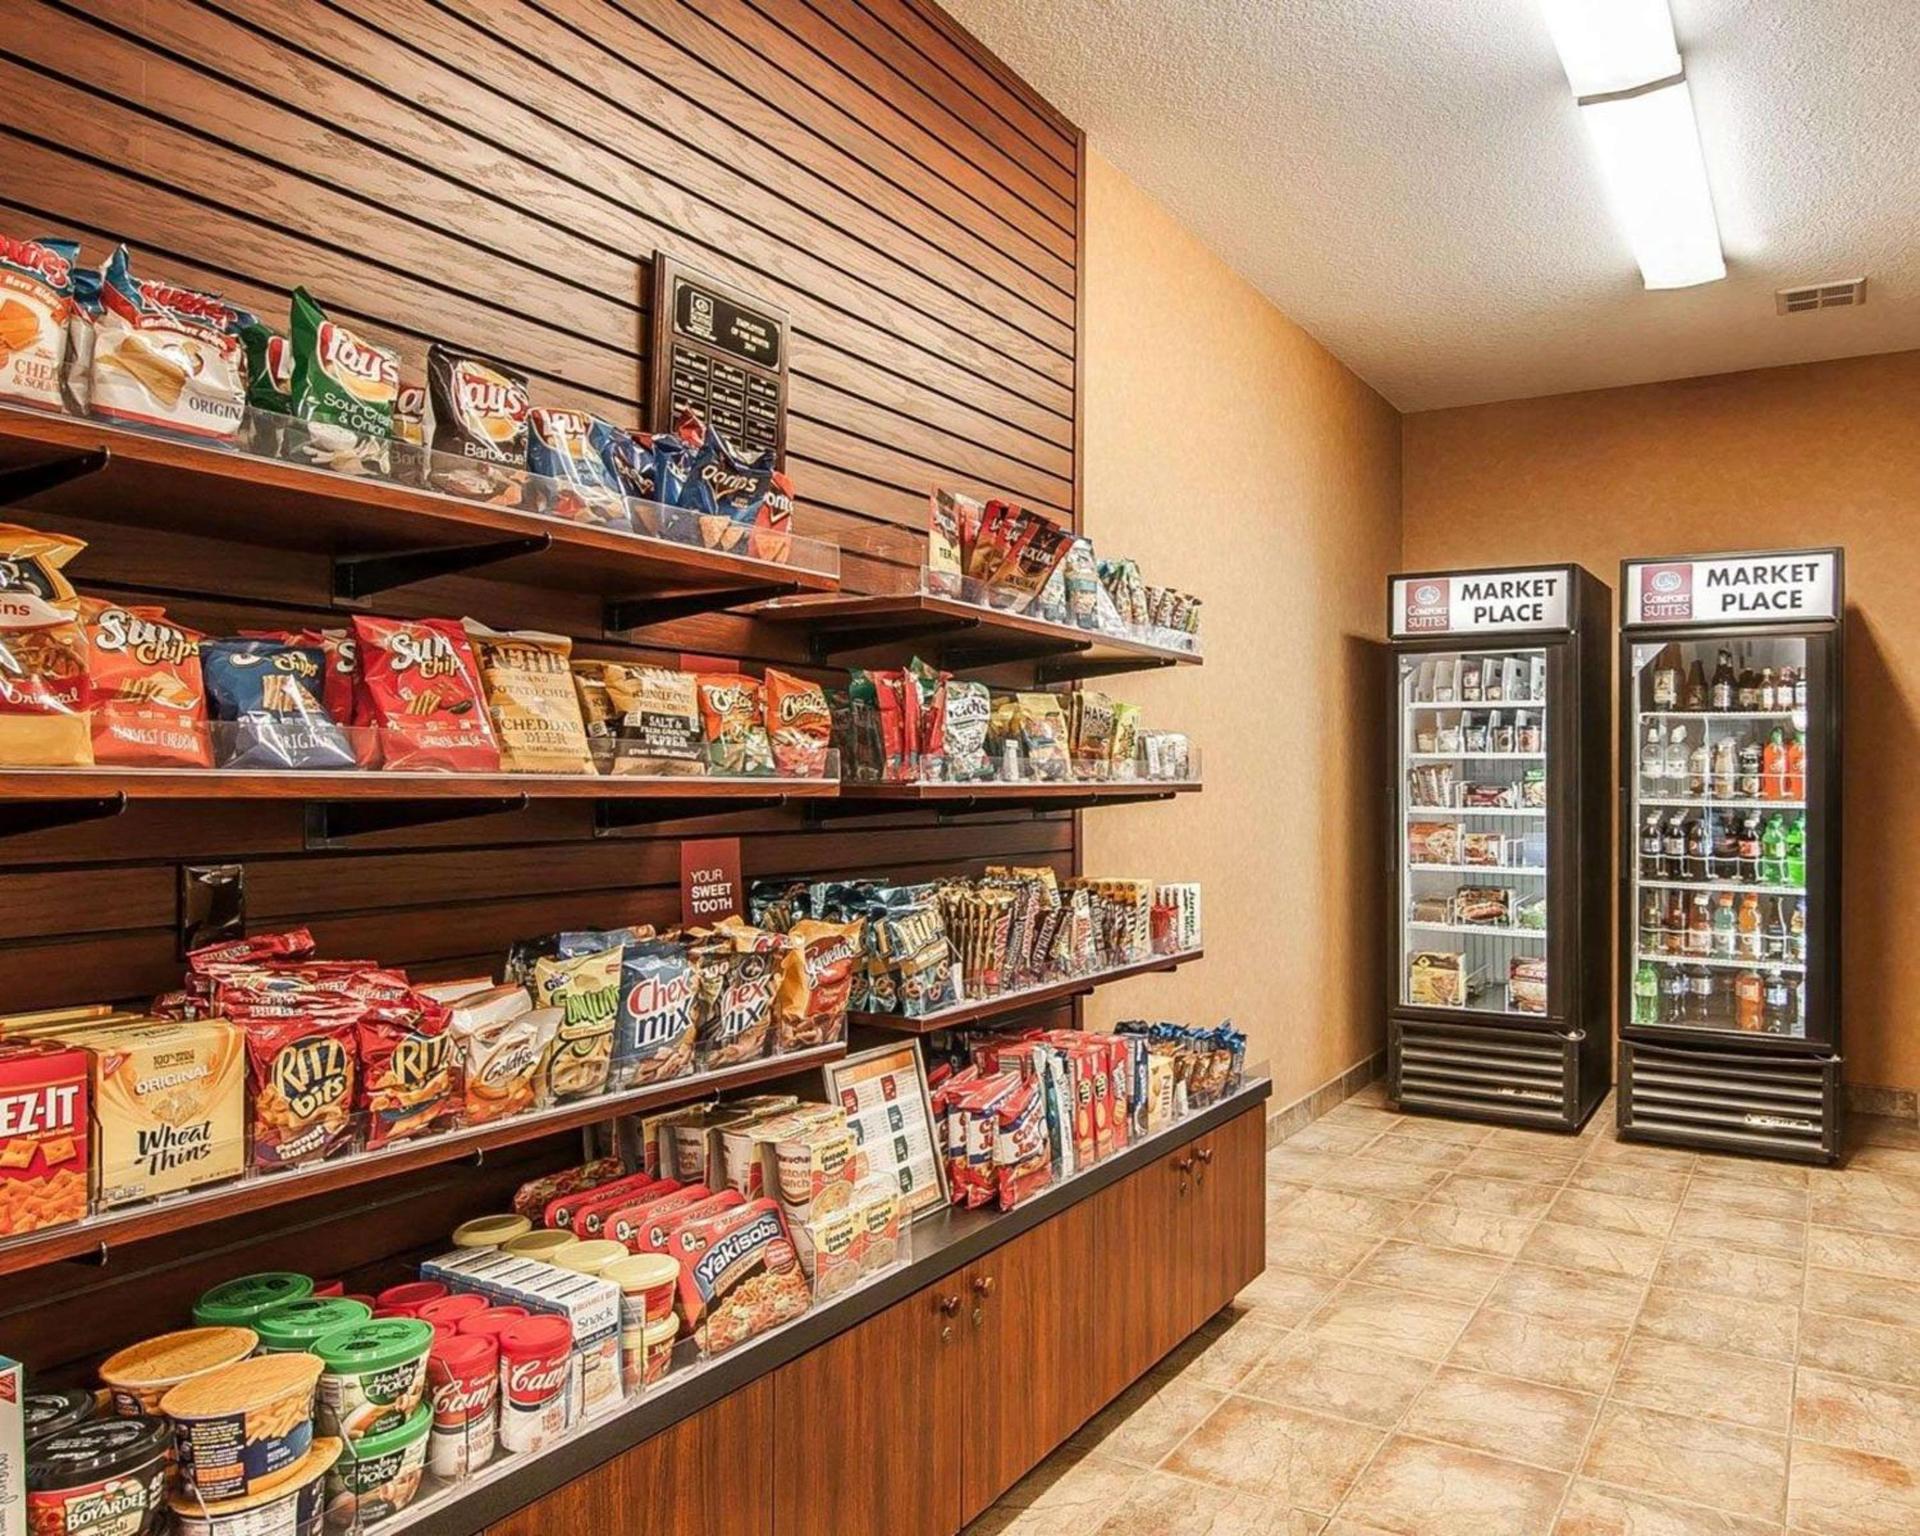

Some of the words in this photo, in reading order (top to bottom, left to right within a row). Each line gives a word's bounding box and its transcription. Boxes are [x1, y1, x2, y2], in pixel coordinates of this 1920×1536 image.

[324, 392, 360, 413] Sour
[338, 411, 349, 424] &
[350, 414, 386, 436] Onion
[464, 442, 525, 465] Barbecue
[1706, 563, 1819, 587] MARKET
[1461, 578, 1557, 601] MARKET
[1721, 590, 1803, 612] PLACE
[1408, 616, 1447, 628] SUITES
[1474, 603, 1543, 624] PLACE
[1643, 603, 1690, 617] SUITES
[136, 637, 200, 665] Chips
[391, 632, 458, 671] Sun
[501, 718, 578, 733] CHEDDAR
[648, 715, 676, 729] SALT
[690, 868, 723, 884] YOUR
[690, 882, 732, 900] SWEET
[691, 897, 733, 915] TOOTH
[627, 976, 692, 1017] Chex
[134, 1065, 209, 1096] ORIGINAL
[278, 1039, 343, 1098] RITZ
[291, 1077, 345, 1119] bits
[137, 1121, 213, 1155] Wheat
[275, 1124, 325, 1154] Peanut
[280, 1134, 326, 1160] Butter
[134, 1143, 212, 1176] Thins
[700, 1220, 778, 1281] Yakisoba
[577, 1306, 614, 1328] Snack
[364, 1372, 414, 1397] Choice
[344, 1462, 398, 1487] Choice
[66, 1489, 148, 1531] BOYARDEE
